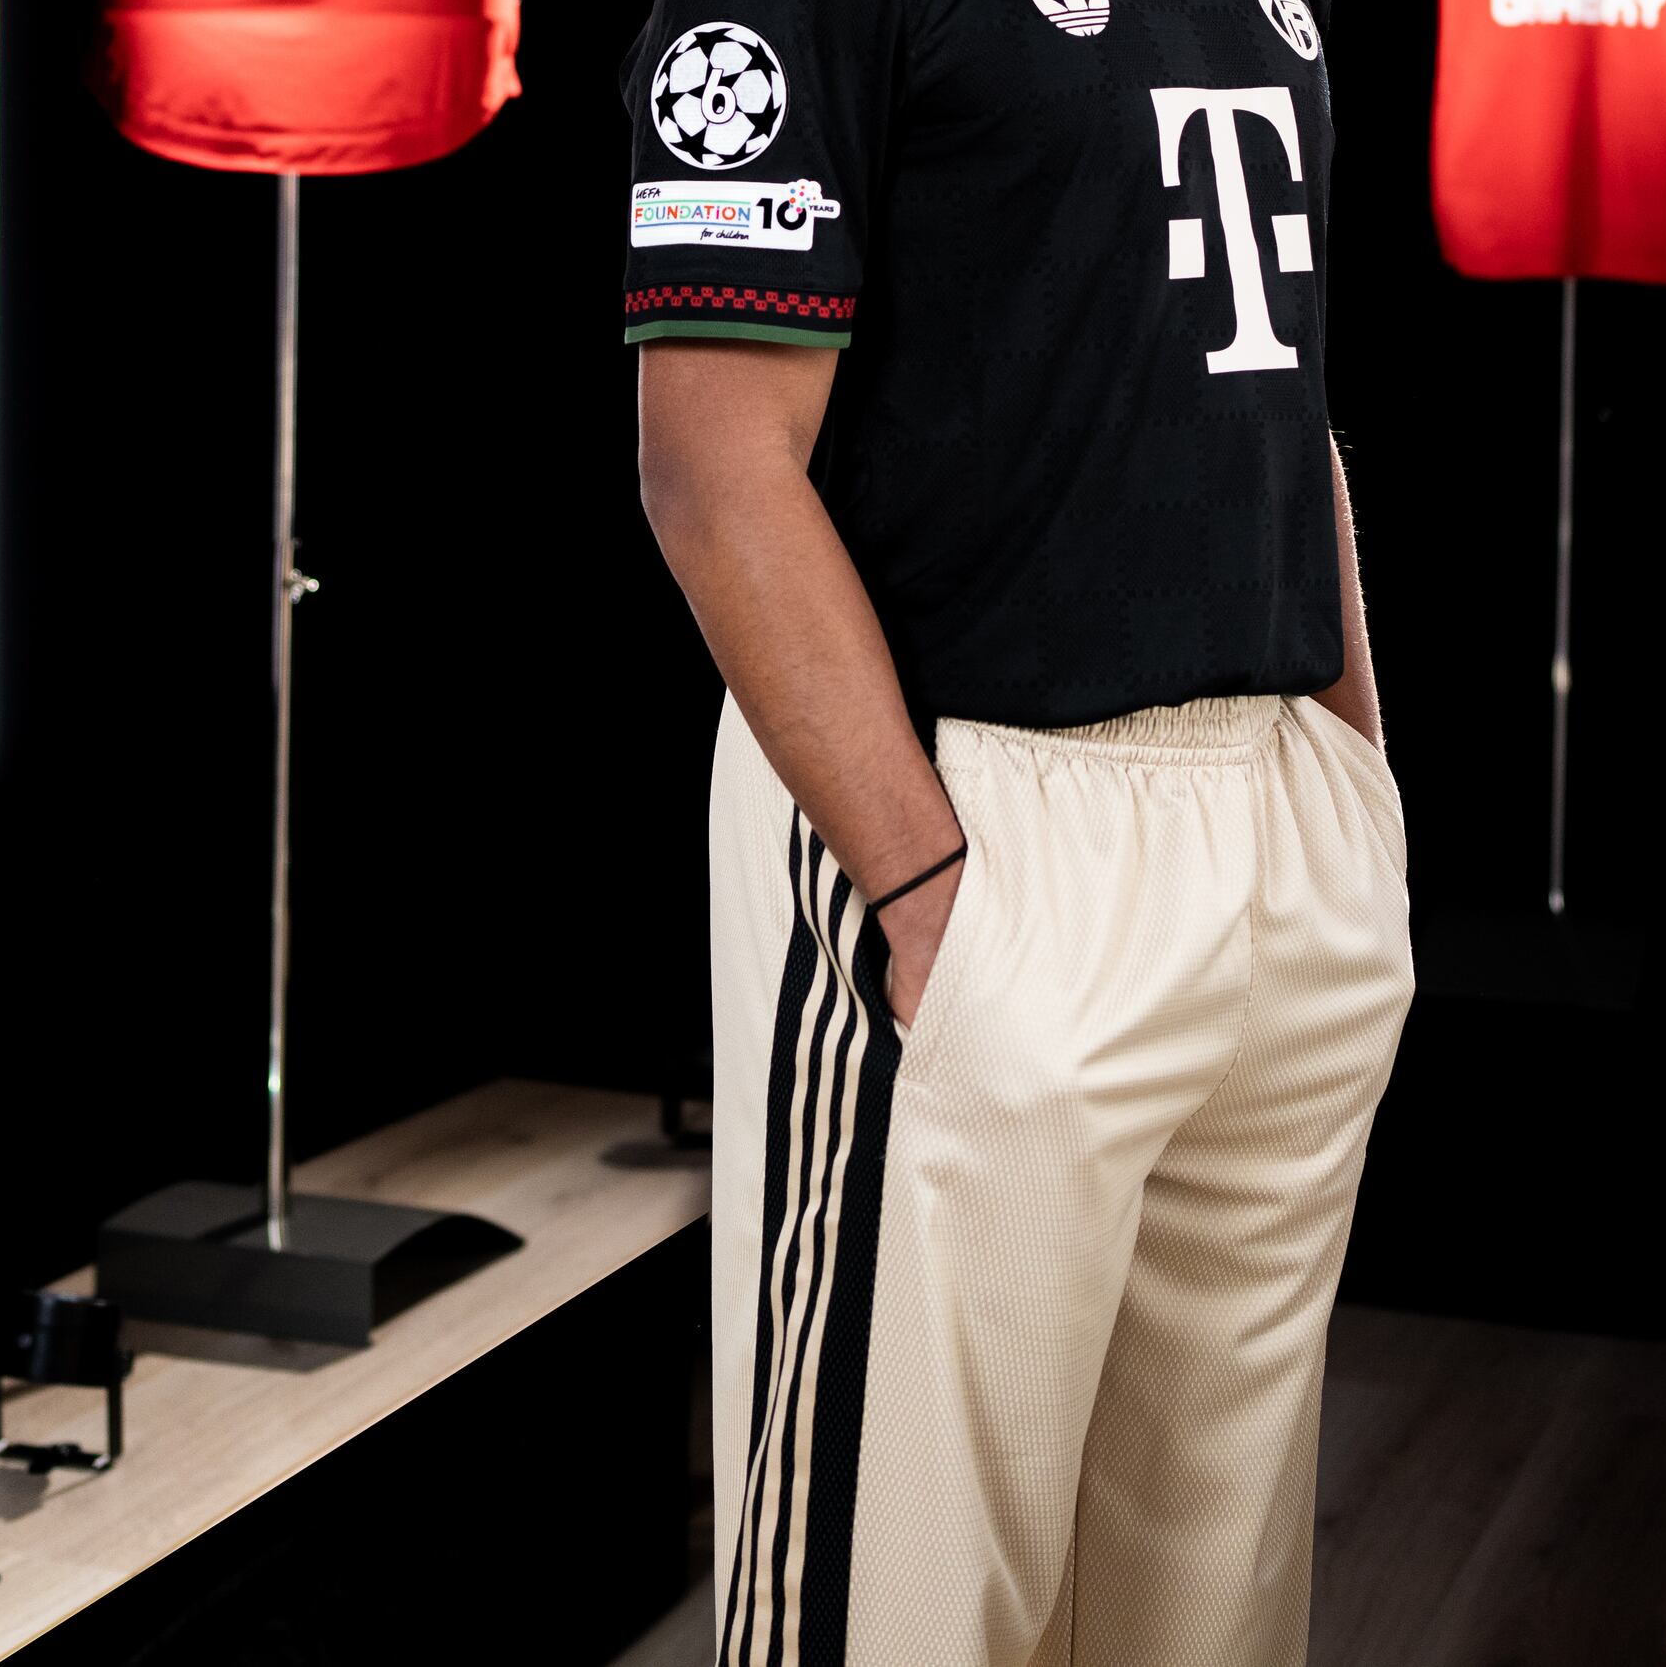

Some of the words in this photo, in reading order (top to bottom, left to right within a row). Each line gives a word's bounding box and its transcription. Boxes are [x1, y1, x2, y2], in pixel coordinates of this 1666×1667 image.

[701, 68, 737, 124] 6
[636, 188, 661, 200] UEFA
[634, 204, 751, 223] FOUNDATION
[756, 197, 808, 231] 10
[700, 227, 714, 241] for
[716, 227, 750, 241] children
[1150, 87, 1314, 374] T
